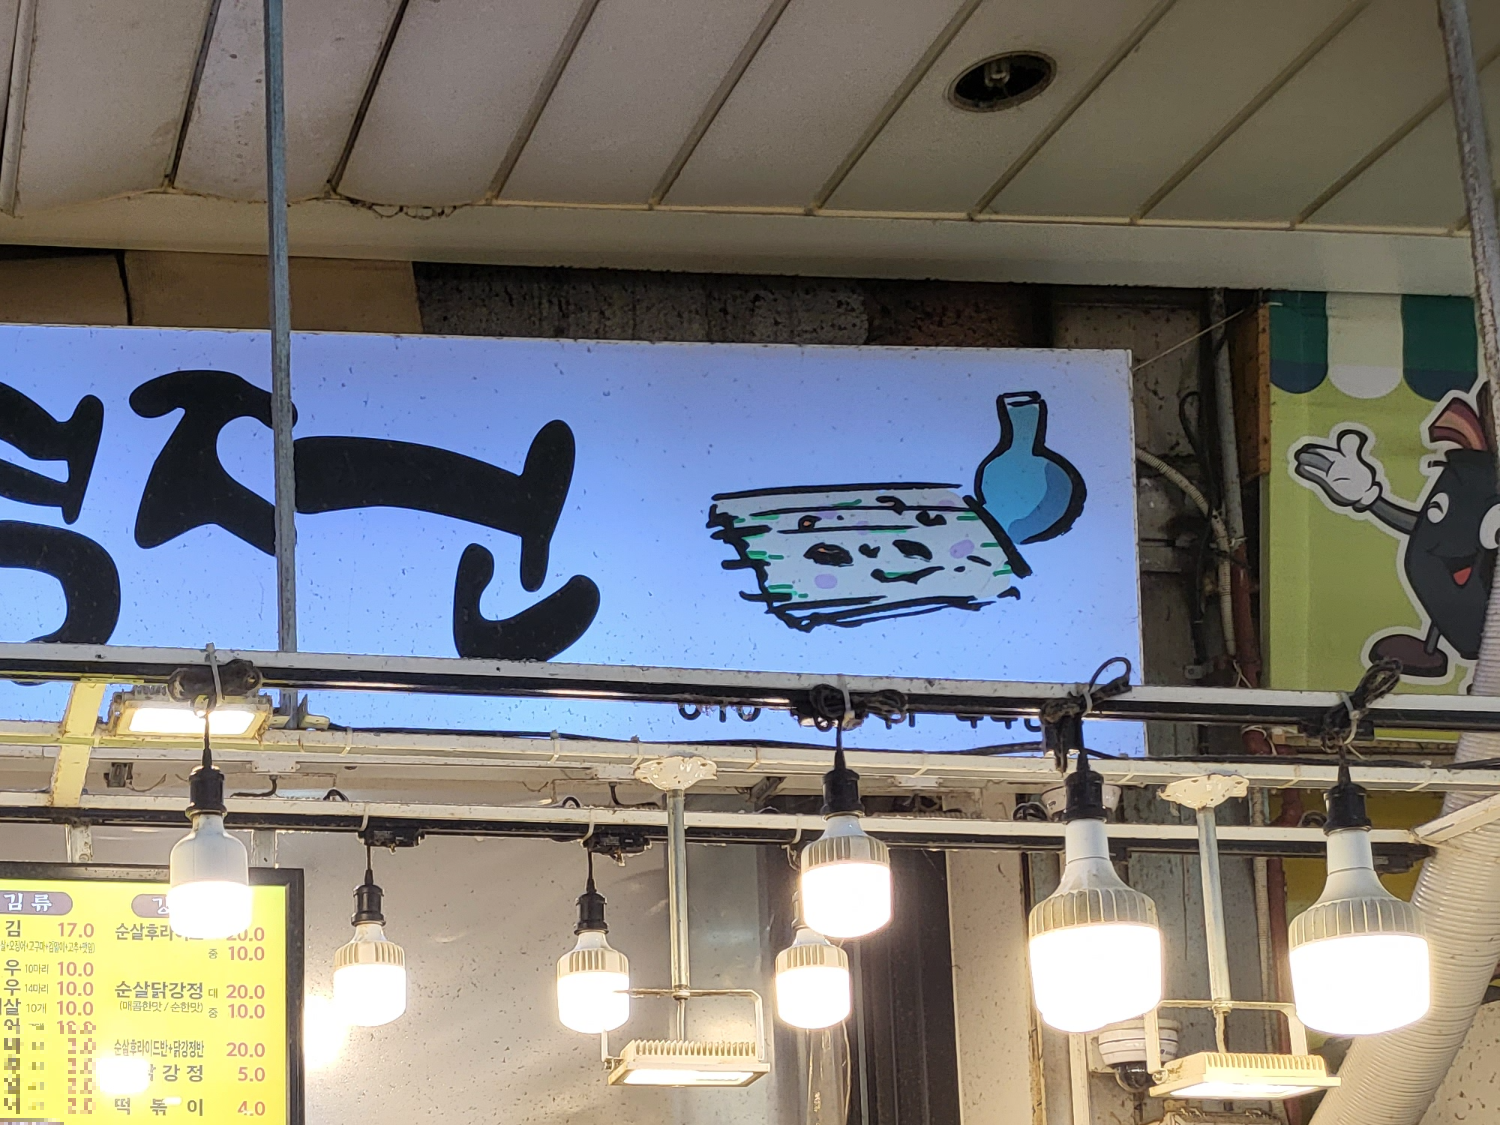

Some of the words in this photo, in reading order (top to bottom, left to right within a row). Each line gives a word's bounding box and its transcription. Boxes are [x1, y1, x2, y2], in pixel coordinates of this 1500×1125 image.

[58, 922, 94, 938] 17.0
[208, 949, 218, 959] 중
[229, 946, 264, 961] 10.0
[58, 962, 93, 977] 10.0
[57, 981, 93, 996] 10.0
[115, 981, 203, 1000] 순살닭강정
[208, 988, 218, 998] 대
[226, 984, 265, 999] 20.0
[26, 1003, 46, 1014] 10개
[57, 1001, 93, 1016] 10.0
[170, 1002, 203, 1013] 순한맛)
[208, 1008, 218, 1018] 중
[228, 1004, 265, 1019] 10.0
[226, 1042, 265, 1057] 20.0
[238, 1067, 265, 1082] 5.0
[114, 1097, 203, 1117] 떡볶이
[238, 1101, 265, 1116] 4.0
